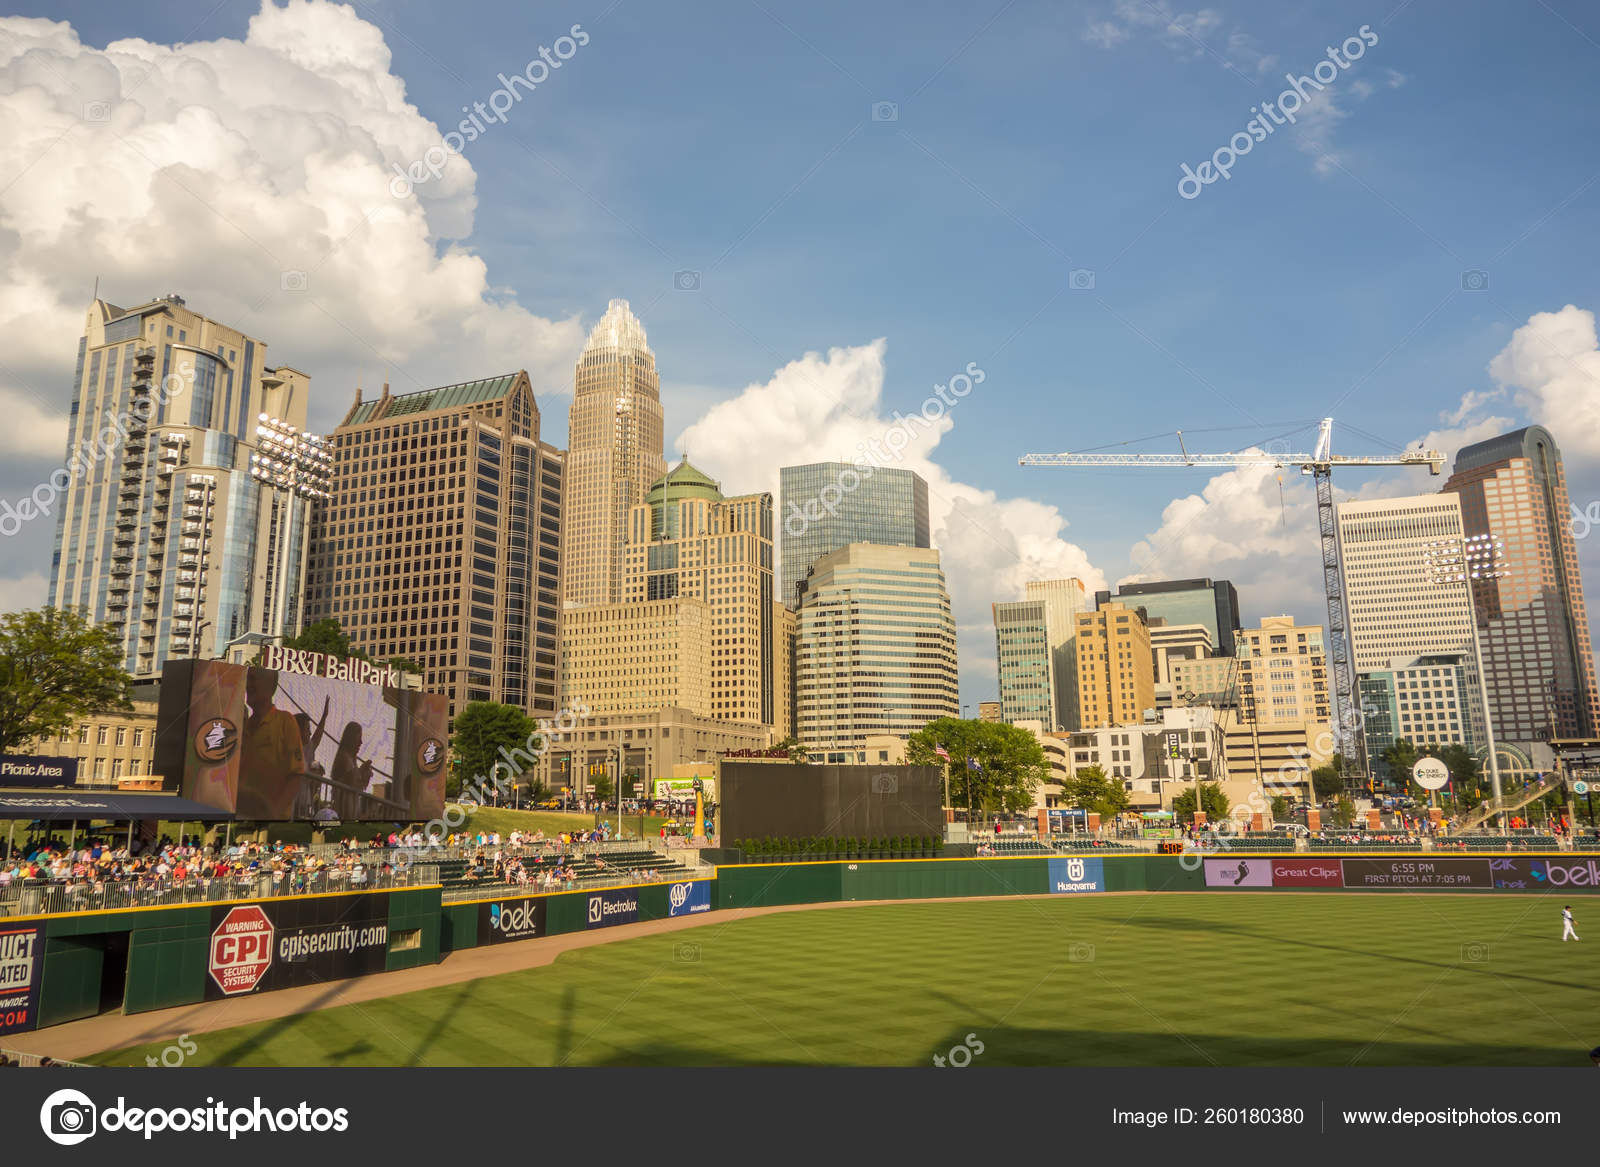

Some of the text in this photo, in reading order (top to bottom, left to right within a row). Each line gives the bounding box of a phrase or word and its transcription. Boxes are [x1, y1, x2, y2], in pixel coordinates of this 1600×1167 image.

[264, 644, 399, 689] BB&T BallPark
[1, 762, 63, 777] Picnic Area
[1274, 866, 1338, 879] Great Clips
[1391, 863, 1435, 873] 6:55 PM
[1057, 881, 1097, 891] Husqvarna
[1364, 874, 1471, 883] FIRST PITCH AT 7:05 PM
[602, 899, 637, 915] Electrolux
[500, 900, 536, 932] belk
[225, 920, 264, 933] WARNING
[215, 934, 269, 965] CPI
[279, 925, 387, 962] cpisecurity.com
[223, 964, 258, 978] SECURITY
[223, 973, 257, 988] SYSTEMS
